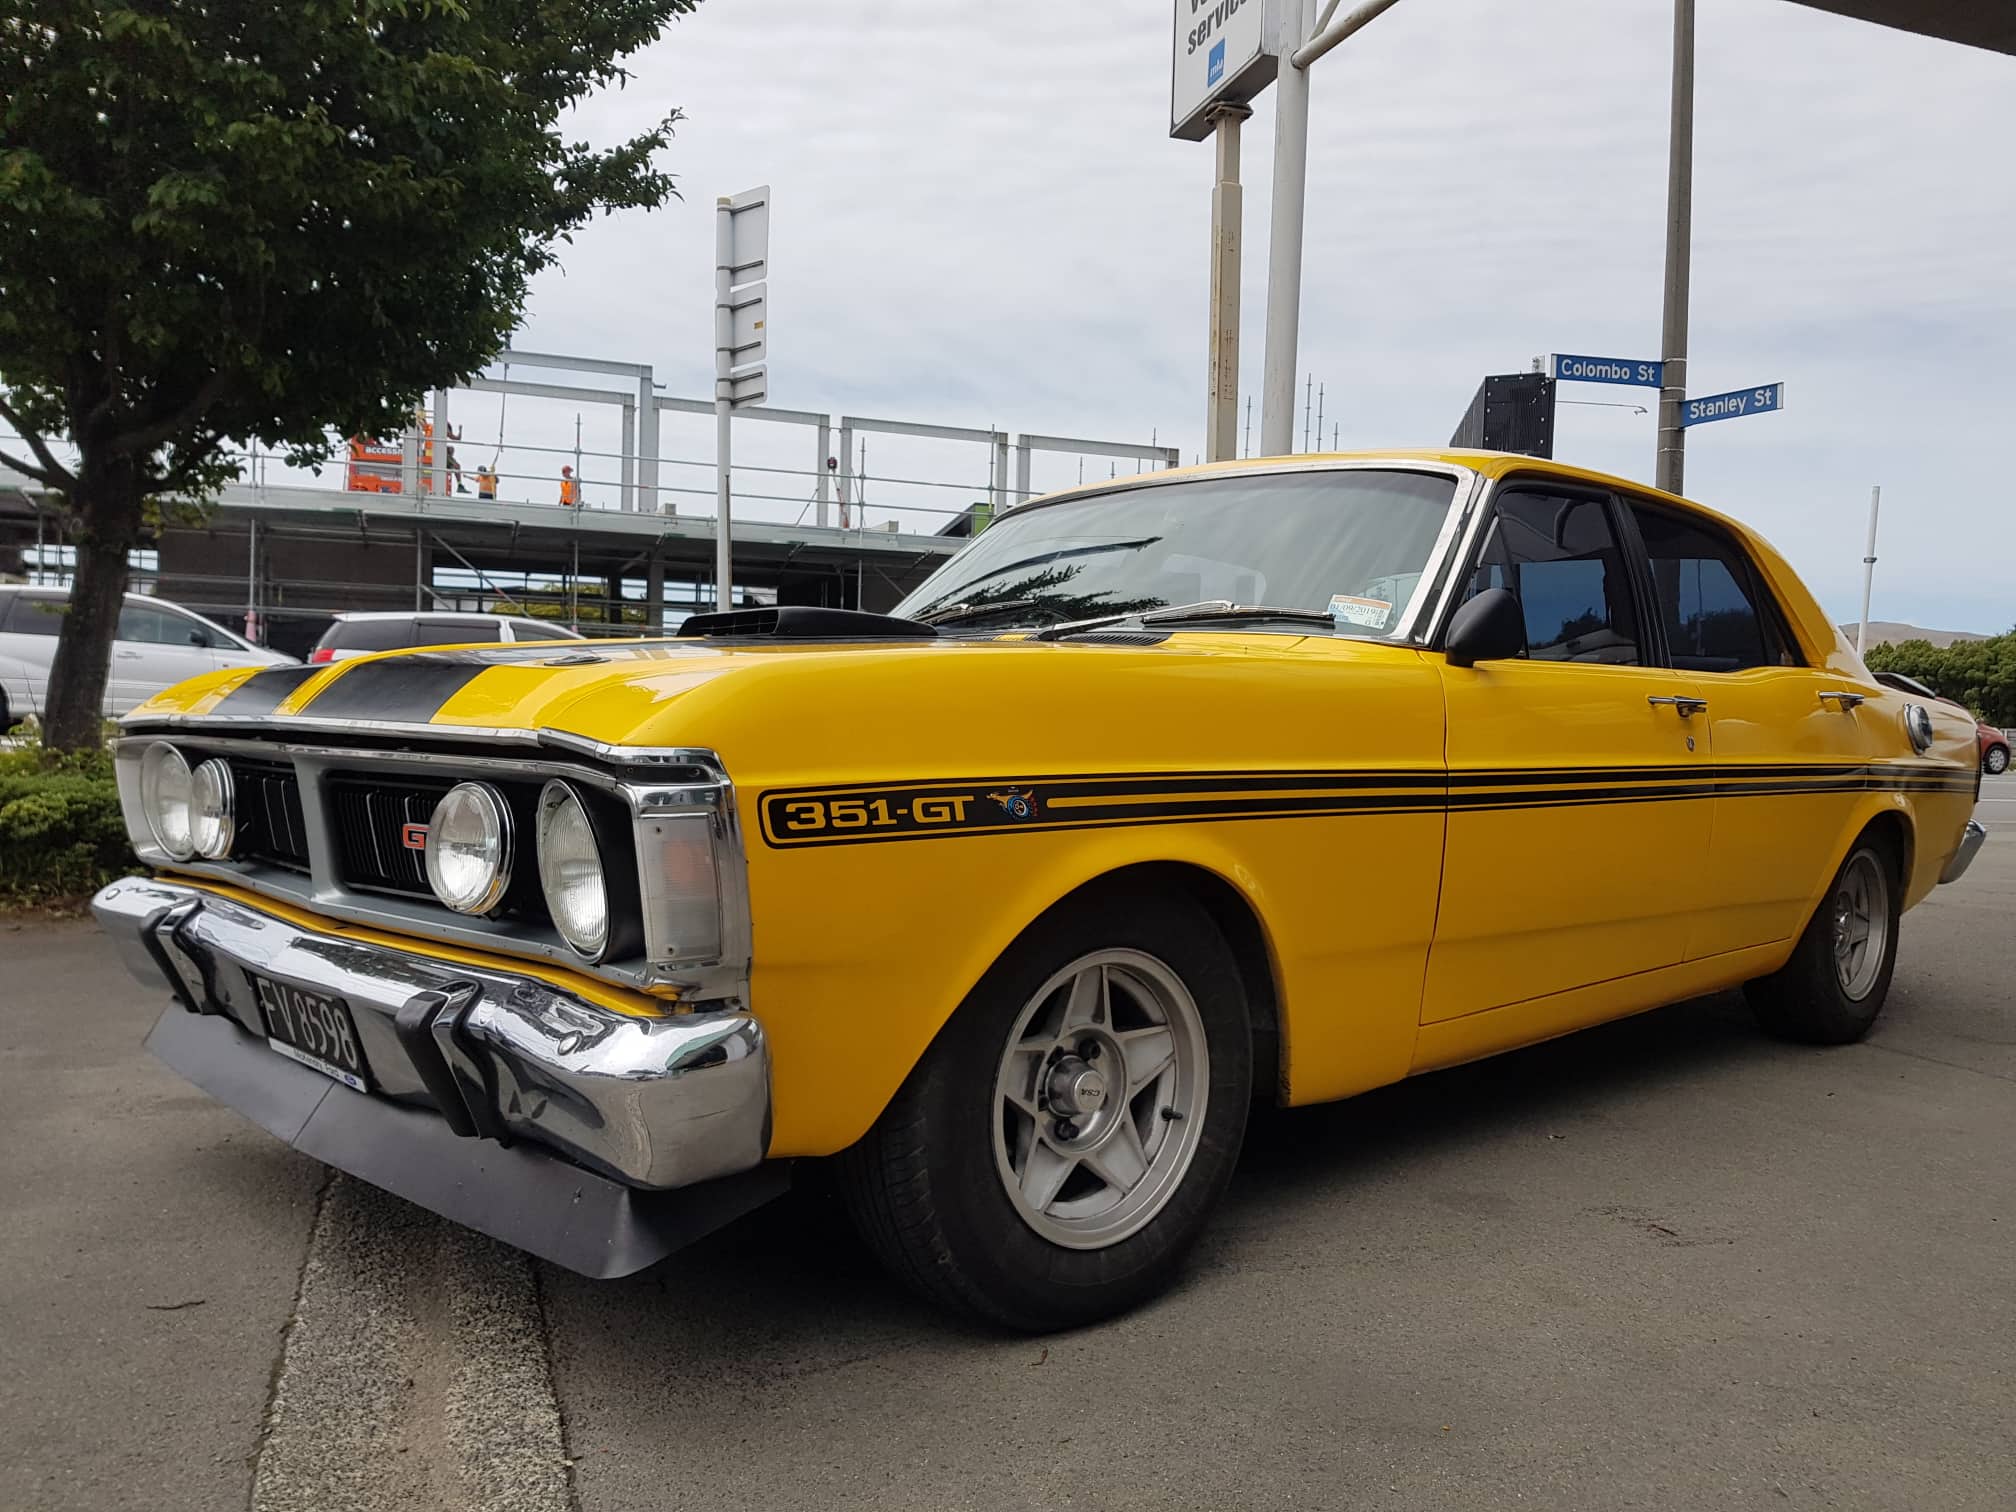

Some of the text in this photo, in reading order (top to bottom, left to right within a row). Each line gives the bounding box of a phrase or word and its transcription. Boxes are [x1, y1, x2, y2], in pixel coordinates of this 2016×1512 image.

[1187, 0, 1246, 55] servic
[1561, 358, 1655, 382] Colombo St
[1689, 389, 1772, 420] Stanley St
